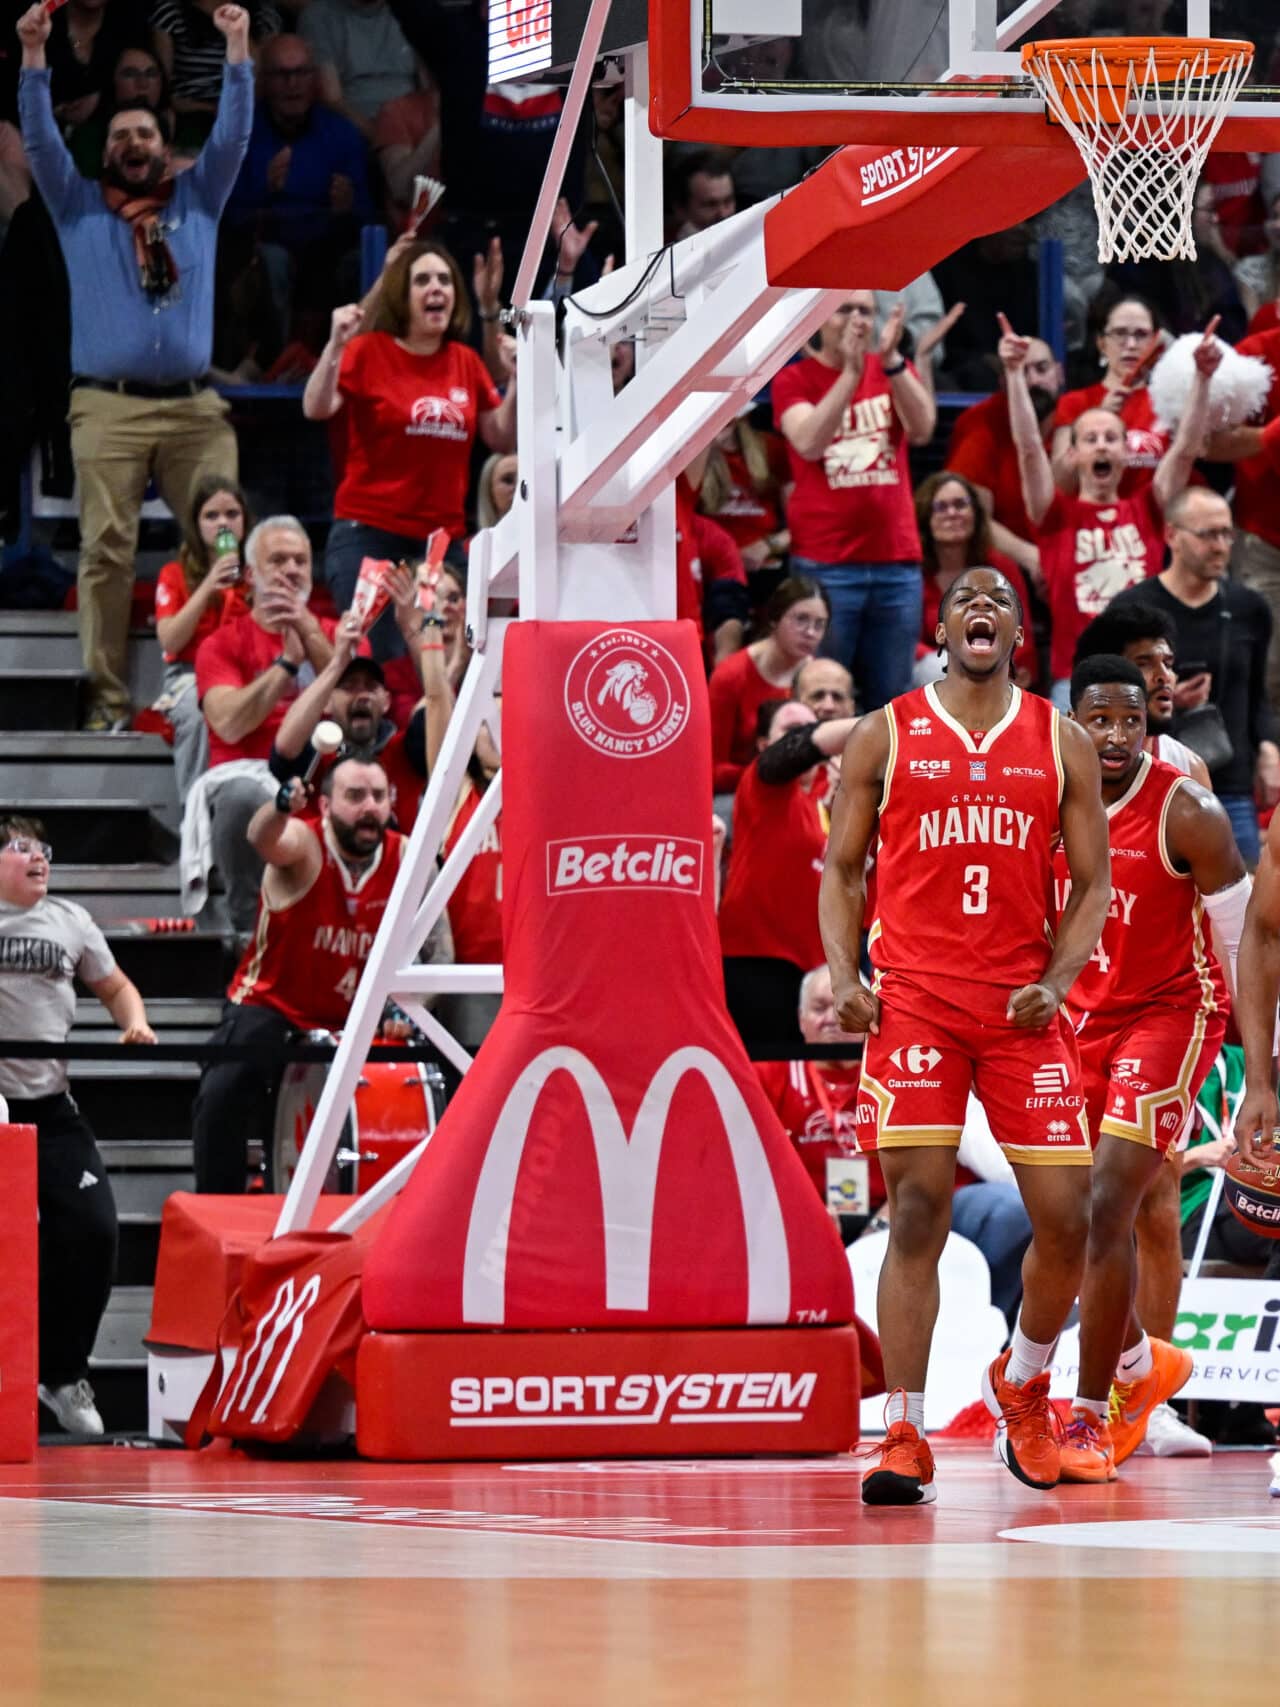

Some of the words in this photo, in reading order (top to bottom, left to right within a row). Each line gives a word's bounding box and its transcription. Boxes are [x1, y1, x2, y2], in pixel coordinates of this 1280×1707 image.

[571, 701, 596, 735] SLUC
[594, 731, 644, 752] NANCY
[647, 701, 684, 748] BASKET
[909, 760, 951, 770] FCGE
[951, 794, 1007, 803] GRAND
[919, 805, 1035, 852] NANCY
[554, 841, 696, 887] Betclic
[962, 864, 989, 914] 3
[887, 1078, 942, 1088] Carrefour
[1025, 1095, 1081, 1109] EIFFAGE
[450, 1372, 819, 1415] SPORTSYSTEM
